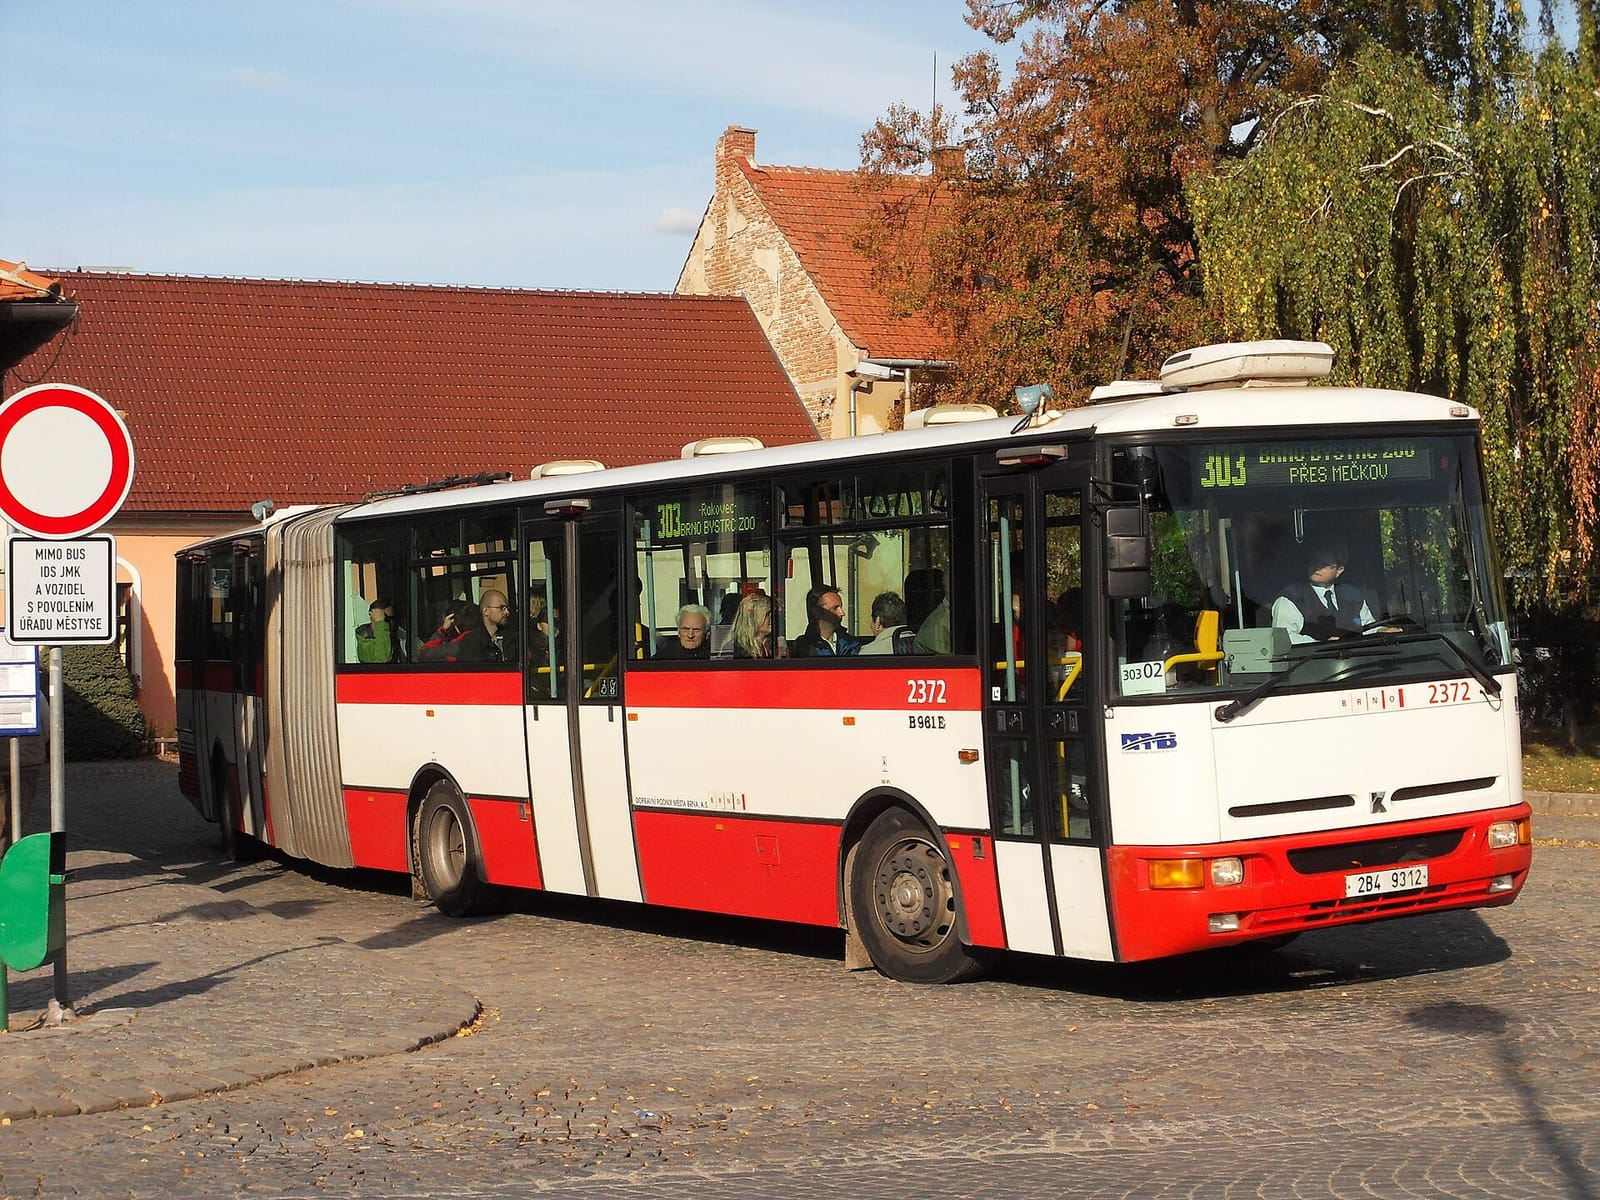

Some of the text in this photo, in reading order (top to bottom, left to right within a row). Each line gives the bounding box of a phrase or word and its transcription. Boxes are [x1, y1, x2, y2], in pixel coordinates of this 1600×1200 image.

[1289, 460, 1389, 484] PŘES MEČKOV
[657, 502, 681, 539] 303
[681, 516, 756, 537] BRNO BYSTRC ZOO
[35, 548, 86, 560] MIMO BUS
[40, 566, 81, 578] IDS JMK
[35, 583, 85, 595] A VOZIDEL
[27, 598, 94, 613] S POVOLENÍM
[20, 616, 102, 631] ÚŘADU MĚSTYSE
[1123, 662, 1163, 681] 303 02
[907, 679, 947, 704] 2372
[1428, 681, 1471, 704] 2372
[1357, 868, 1422, 894] 2B4 9312
